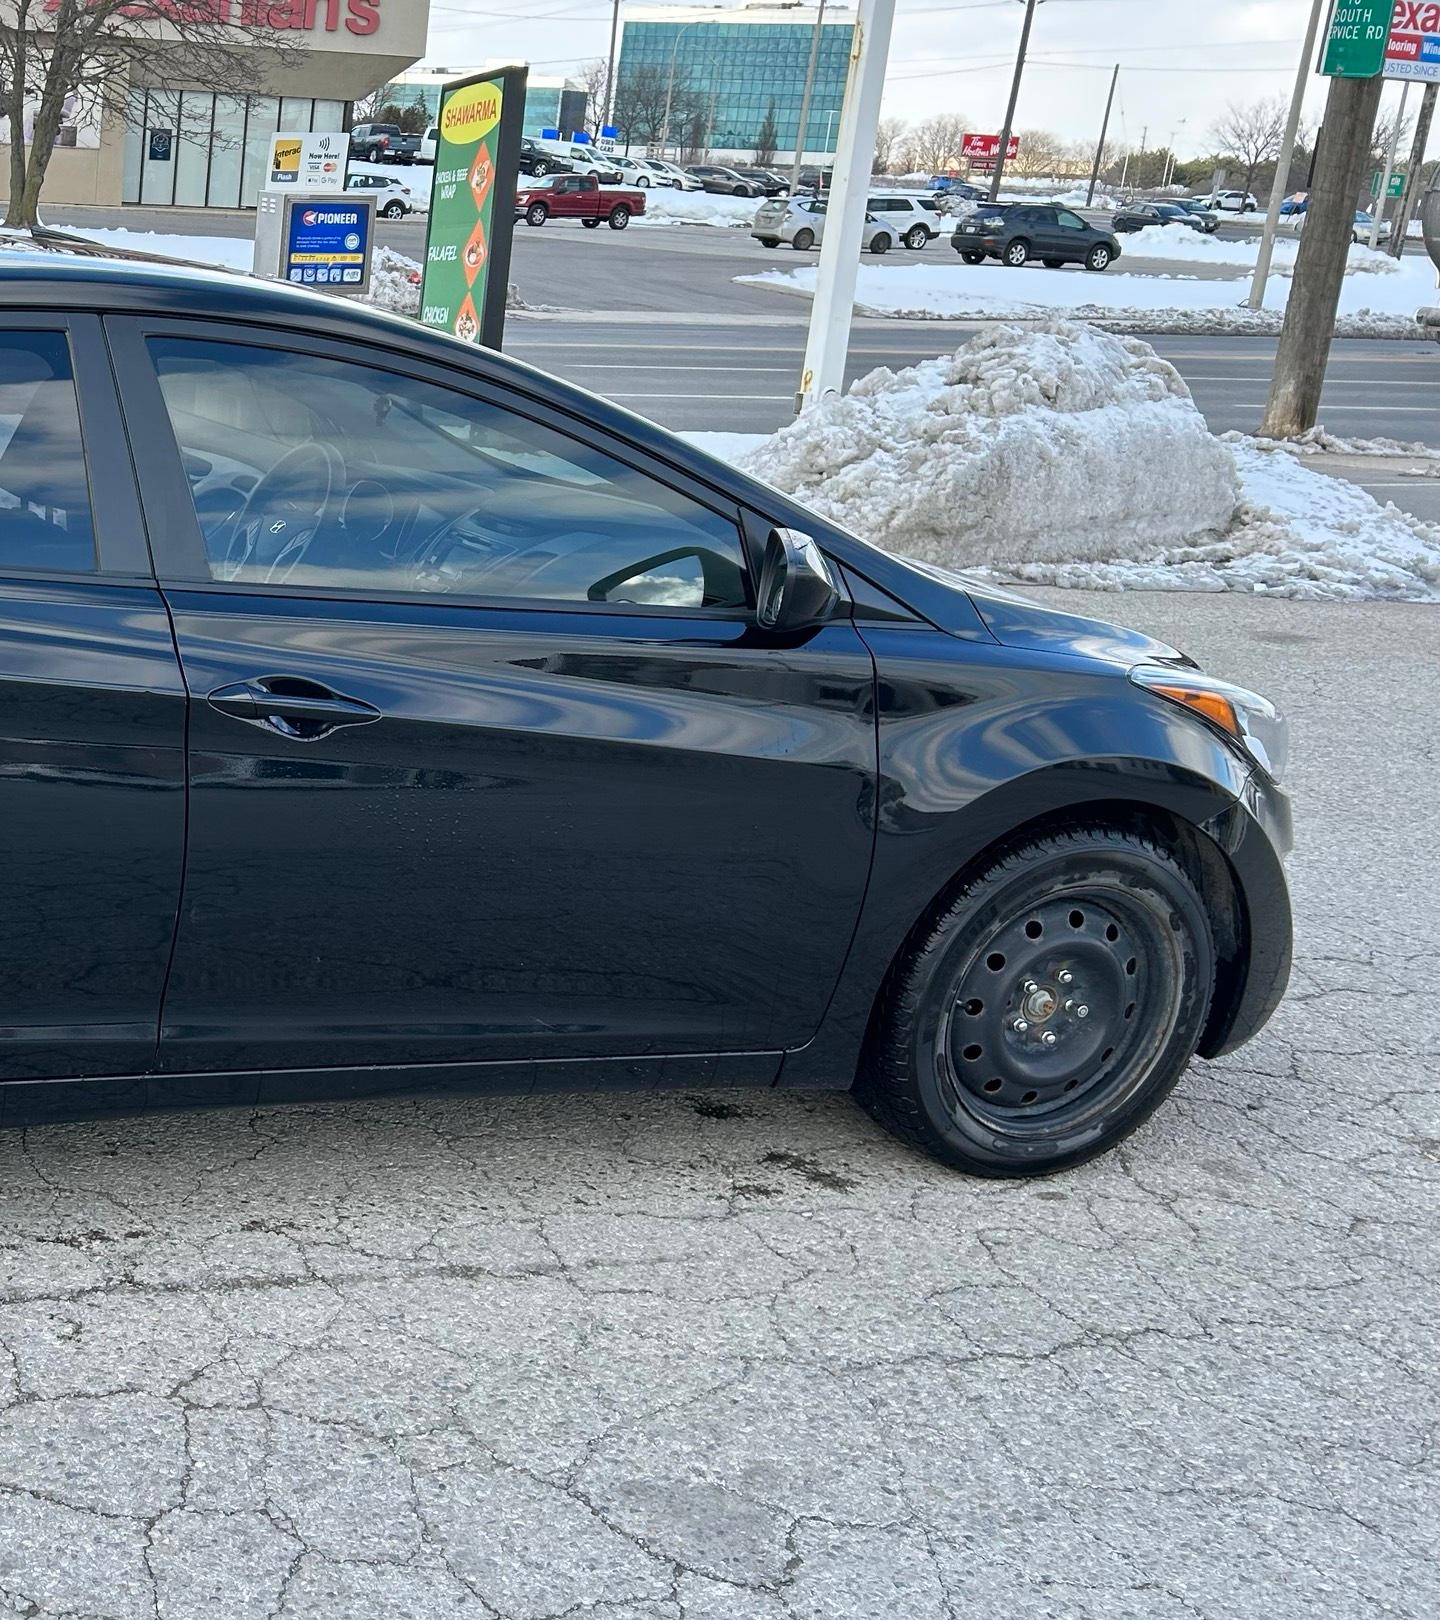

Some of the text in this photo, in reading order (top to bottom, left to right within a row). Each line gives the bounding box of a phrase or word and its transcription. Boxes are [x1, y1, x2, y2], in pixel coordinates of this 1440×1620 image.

[1334, 8, 1373, 23] SOUTH
[1328, 25, 1361, 40] ERVICE
[1388, 38, 1417, 55] looring
[1383, 62, 1439, 77] USTED SINCE
[445, 98, 497, 129] SHAWARMA
[308, 152, 340, 160] Now Here!
[441, 184, 456, 200] WRAP
[317, 212, 358, 225] PIONEER
[428, 245, 457, 262] FALAFEL
[423, 305, 450, 324] CHICKEN
